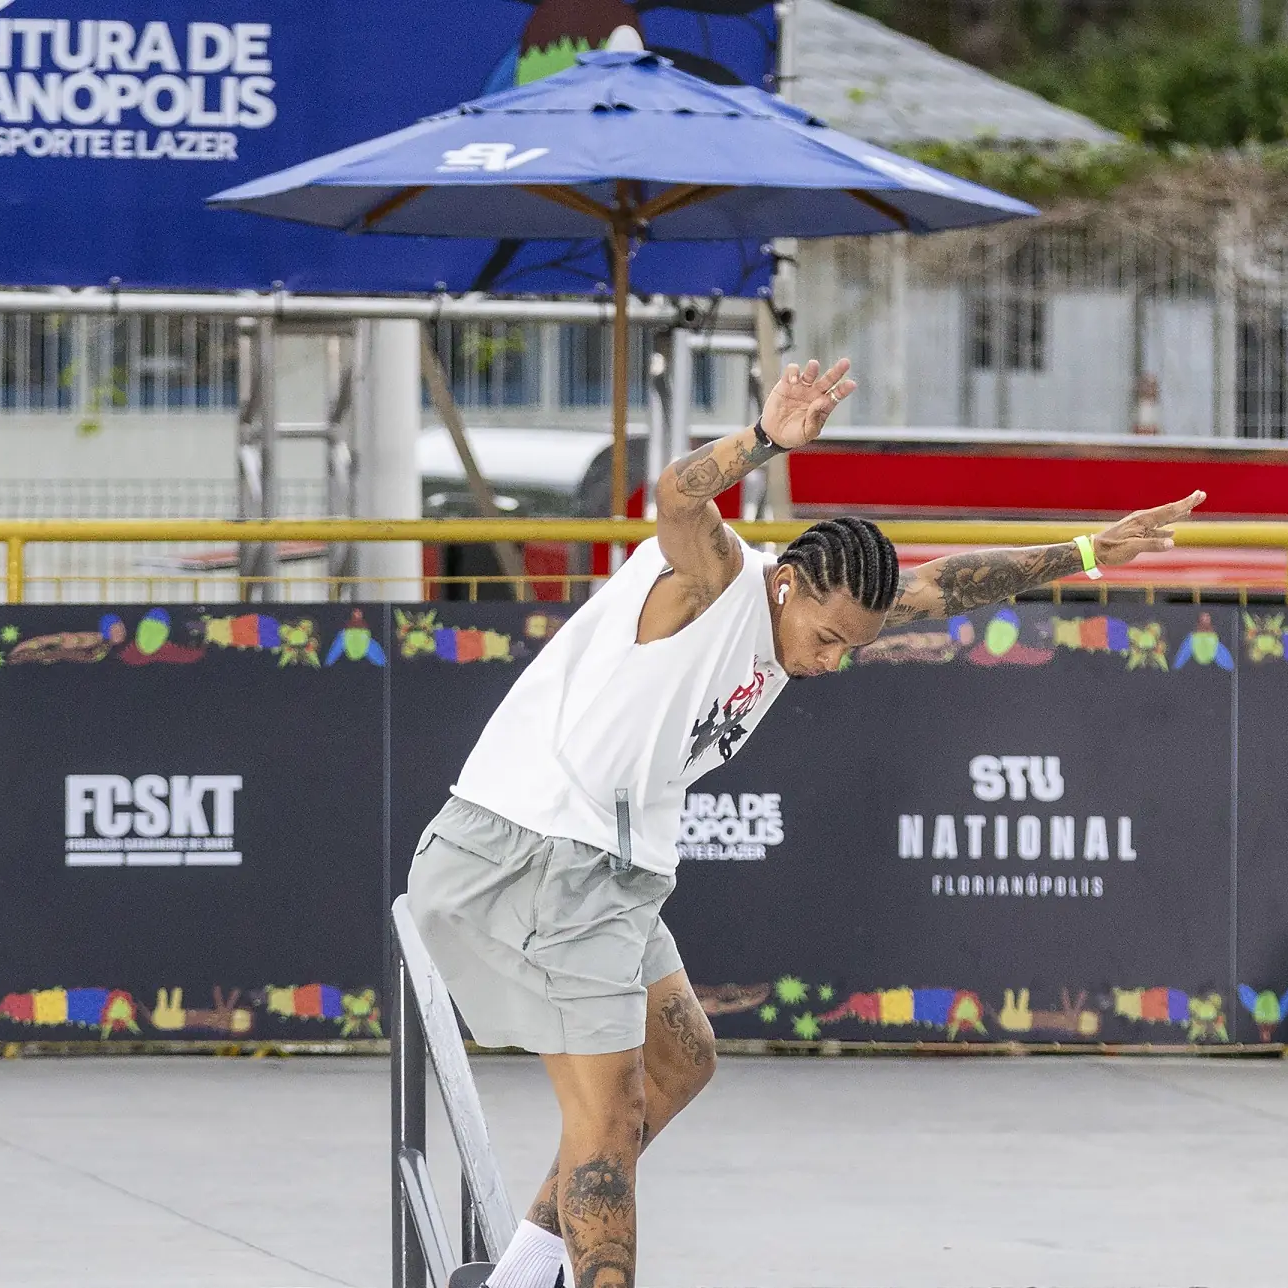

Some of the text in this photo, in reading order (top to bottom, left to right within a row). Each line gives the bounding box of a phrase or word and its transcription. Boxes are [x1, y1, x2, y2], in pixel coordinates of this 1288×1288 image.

[187, 22, 273, 75] DE
[113, 129, 135, 159] E
[136, 130, 239, 161] LAZER
[969, 754, 1064, 802] STU
[65, 774, 243, 837] FCSKT
[739, 793, 782, 819] DE
[898, 814, 1137, 861] NATIONAL
[931, 872, 1104, 898] FLORIANÓPOLIS
